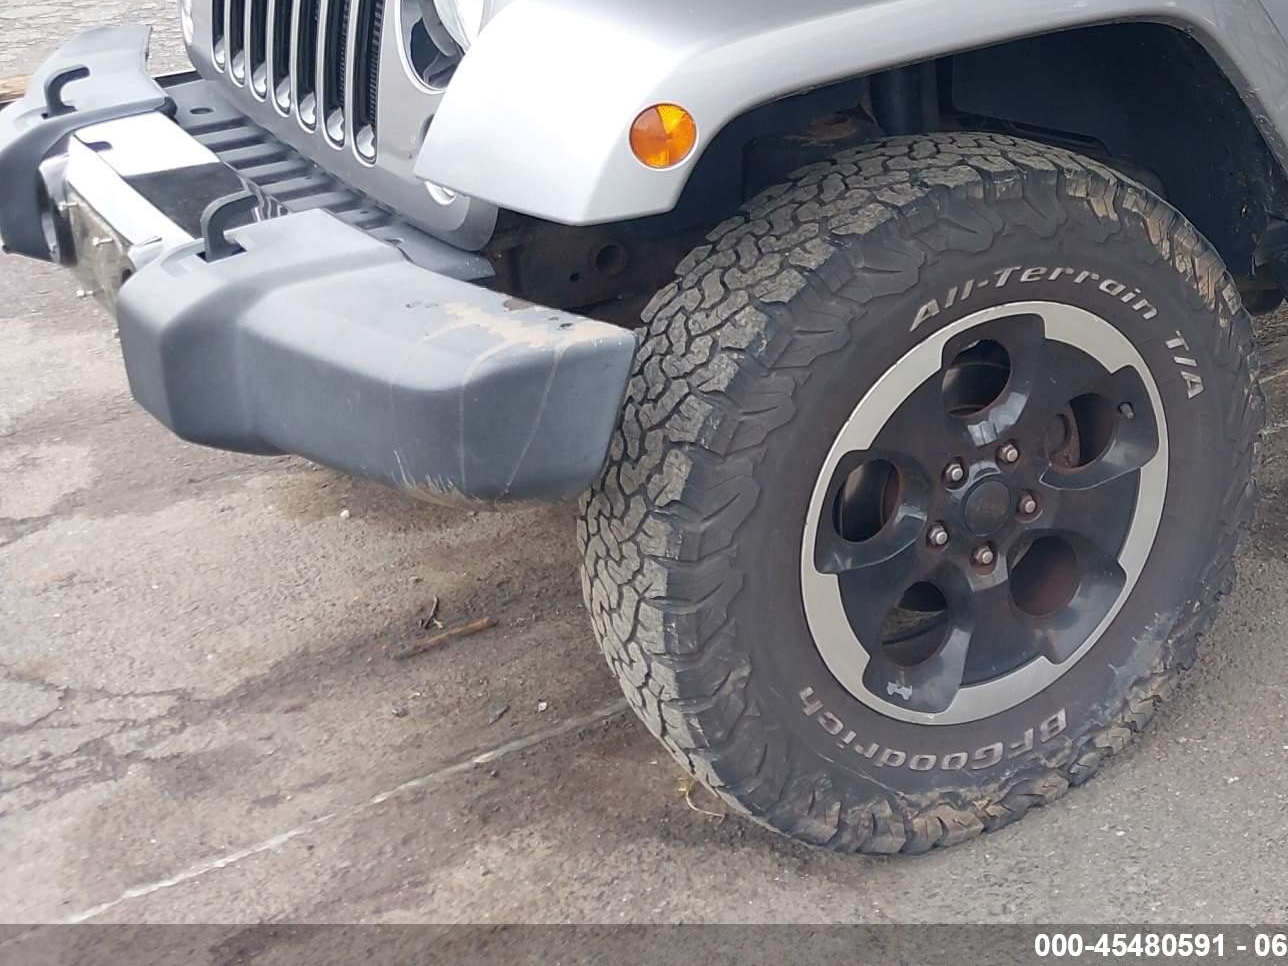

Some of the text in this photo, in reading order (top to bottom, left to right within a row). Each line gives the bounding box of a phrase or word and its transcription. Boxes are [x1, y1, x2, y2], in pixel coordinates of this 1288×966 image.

[909, 265, 1205, 400] All-Terrain T/A
[798, 685, 1068, 771] BFGoodrich
